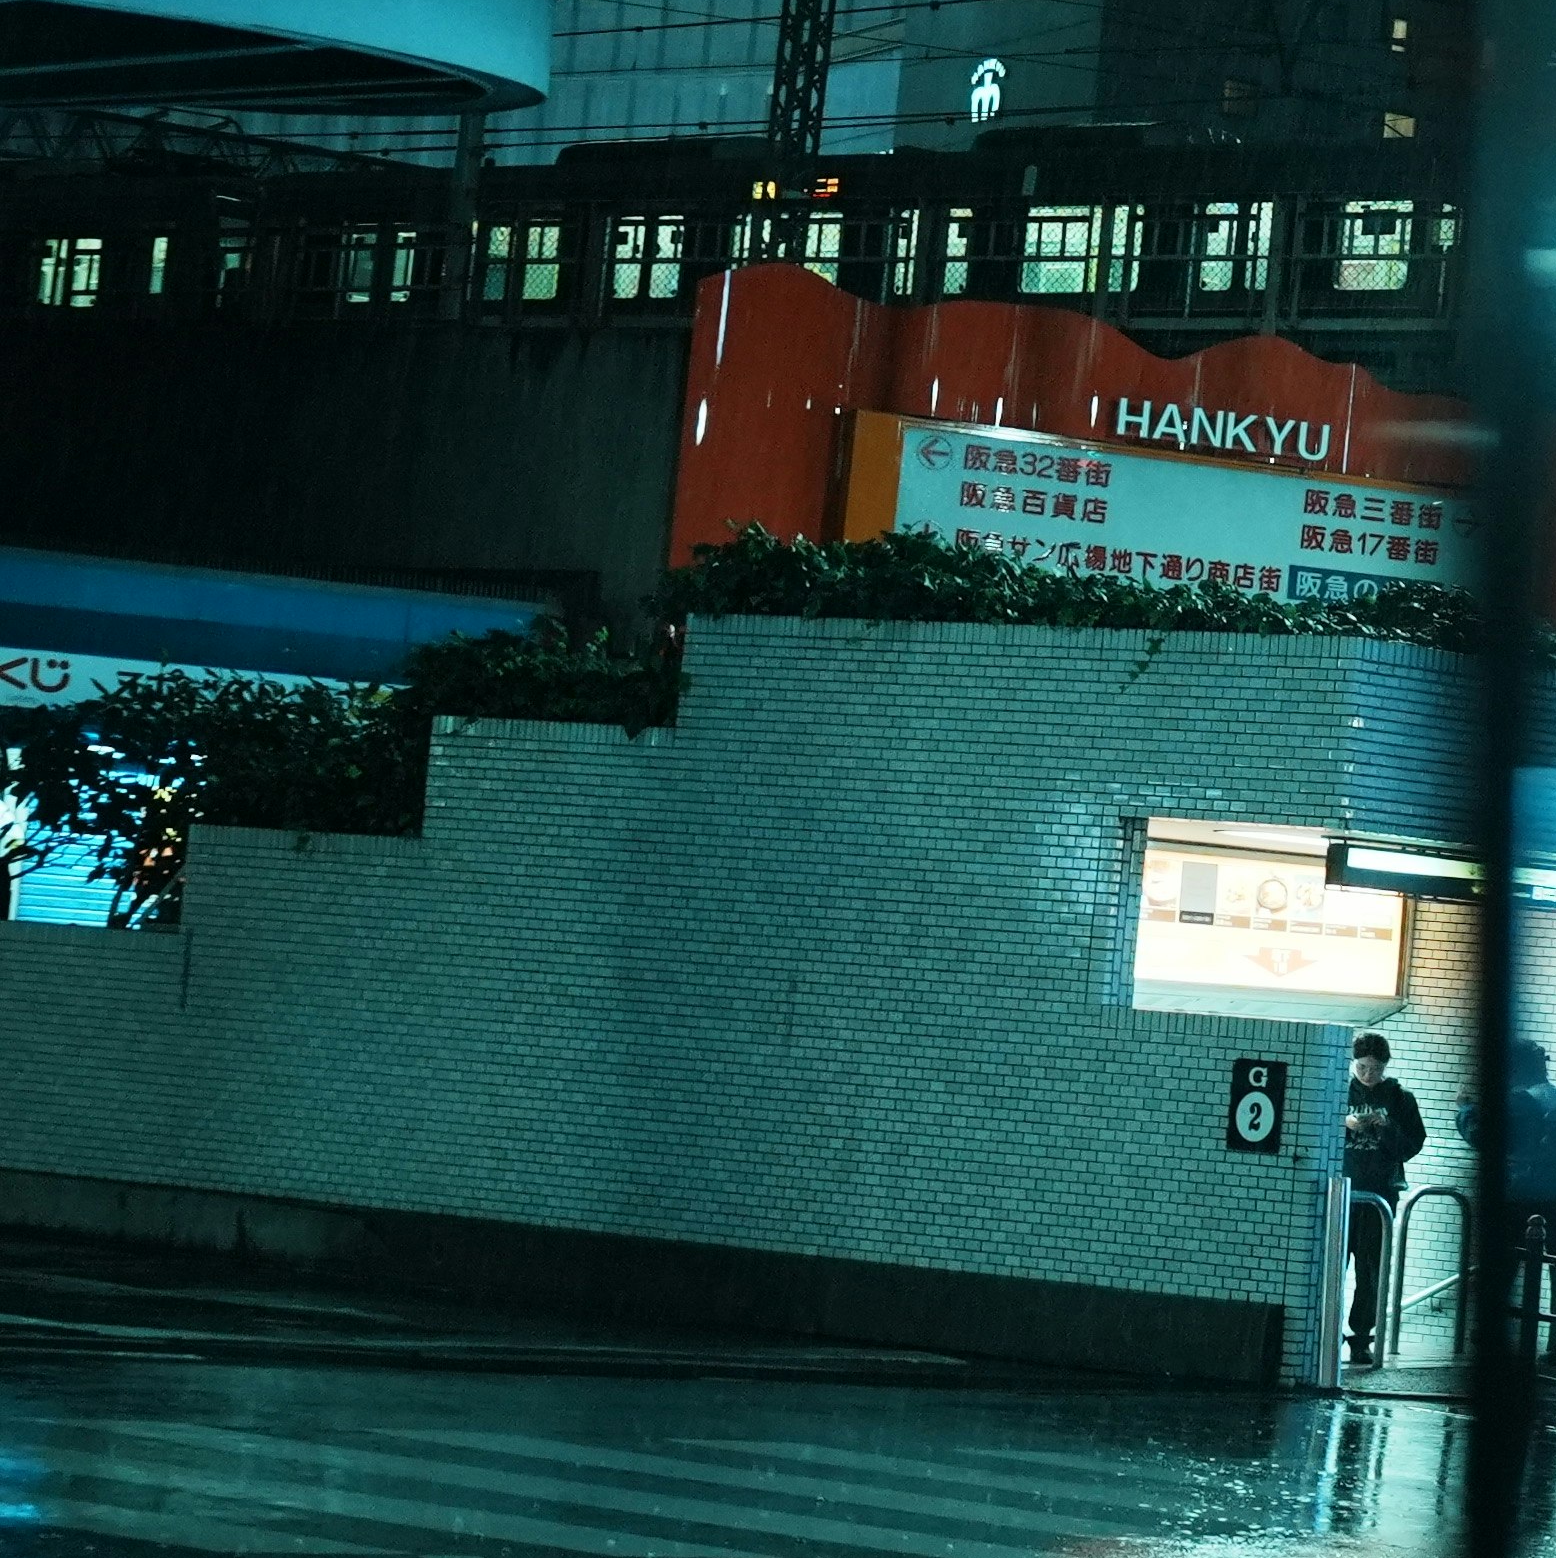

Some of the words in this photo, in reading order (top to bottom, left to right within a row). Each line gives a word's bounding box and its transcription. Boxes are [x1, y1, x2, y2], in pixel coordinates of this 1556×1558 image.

[1114, 396, 1332, 461] HANKYU
[963, 444, 1112, 488] 阪急32番街
[959, 481, 1108, 524] 阪急百貨店
[1303, 488, 1443, 531] 阪急三番街
[1300, 524, 1439, 565] 阪急17番街
[1248, 1066, 1268, 1088] G
[1248, 1102, 1262, 1132] 2
